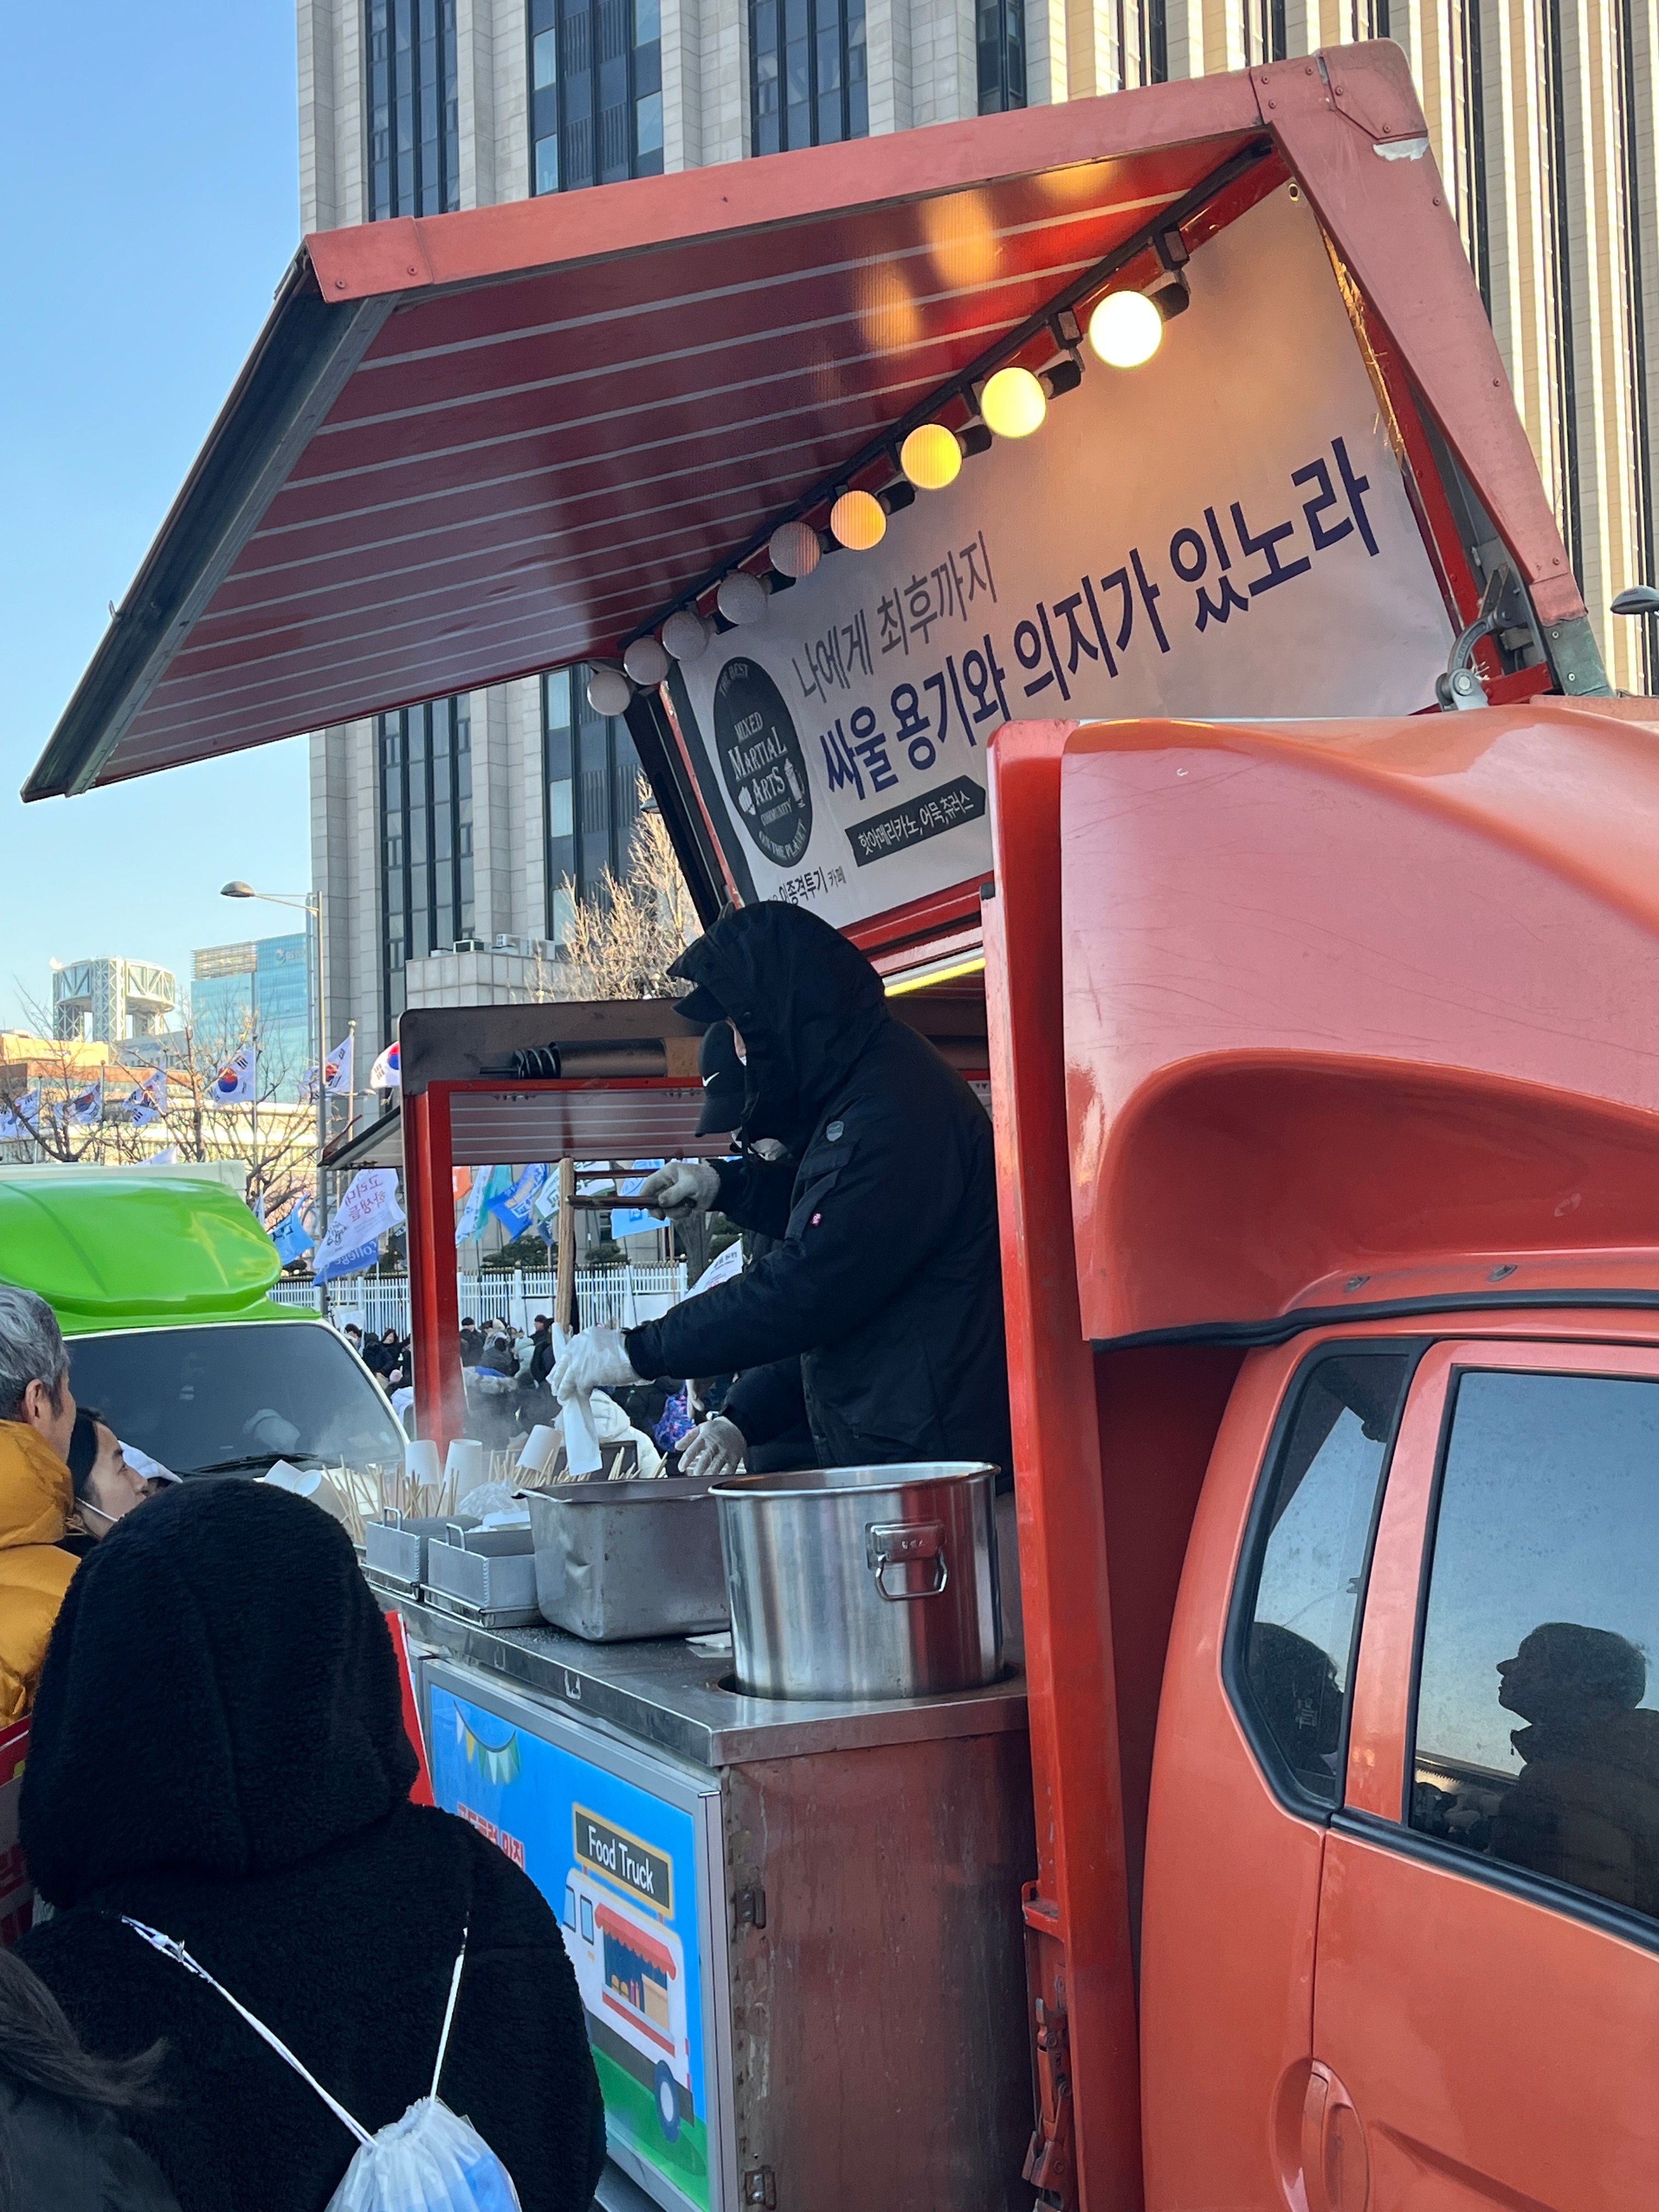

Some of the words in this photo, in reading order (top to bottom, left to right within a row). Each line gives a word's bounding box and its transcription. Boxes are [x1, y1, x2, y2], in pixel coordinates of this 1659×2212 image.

[792, 609, 874, 703] 나에게
[878, 530, 997, 655] 최후까지
[820, 706, 899, 800] 싸울
[890, 633, 1012, 770] 용기와
[1014, 549, 1171, 701] 의지가
[1170, 436, 1380, 633] 있노라
[728, 663, 749, 680] BEST
[734, 712, 763, 742] MIXED
[752, 766, 785, 806] ARTS
[827, 865, 847, 888] 카페
[588, 1825, 616, 1871] Food
[618, 1842, 654, 1894] Truck
